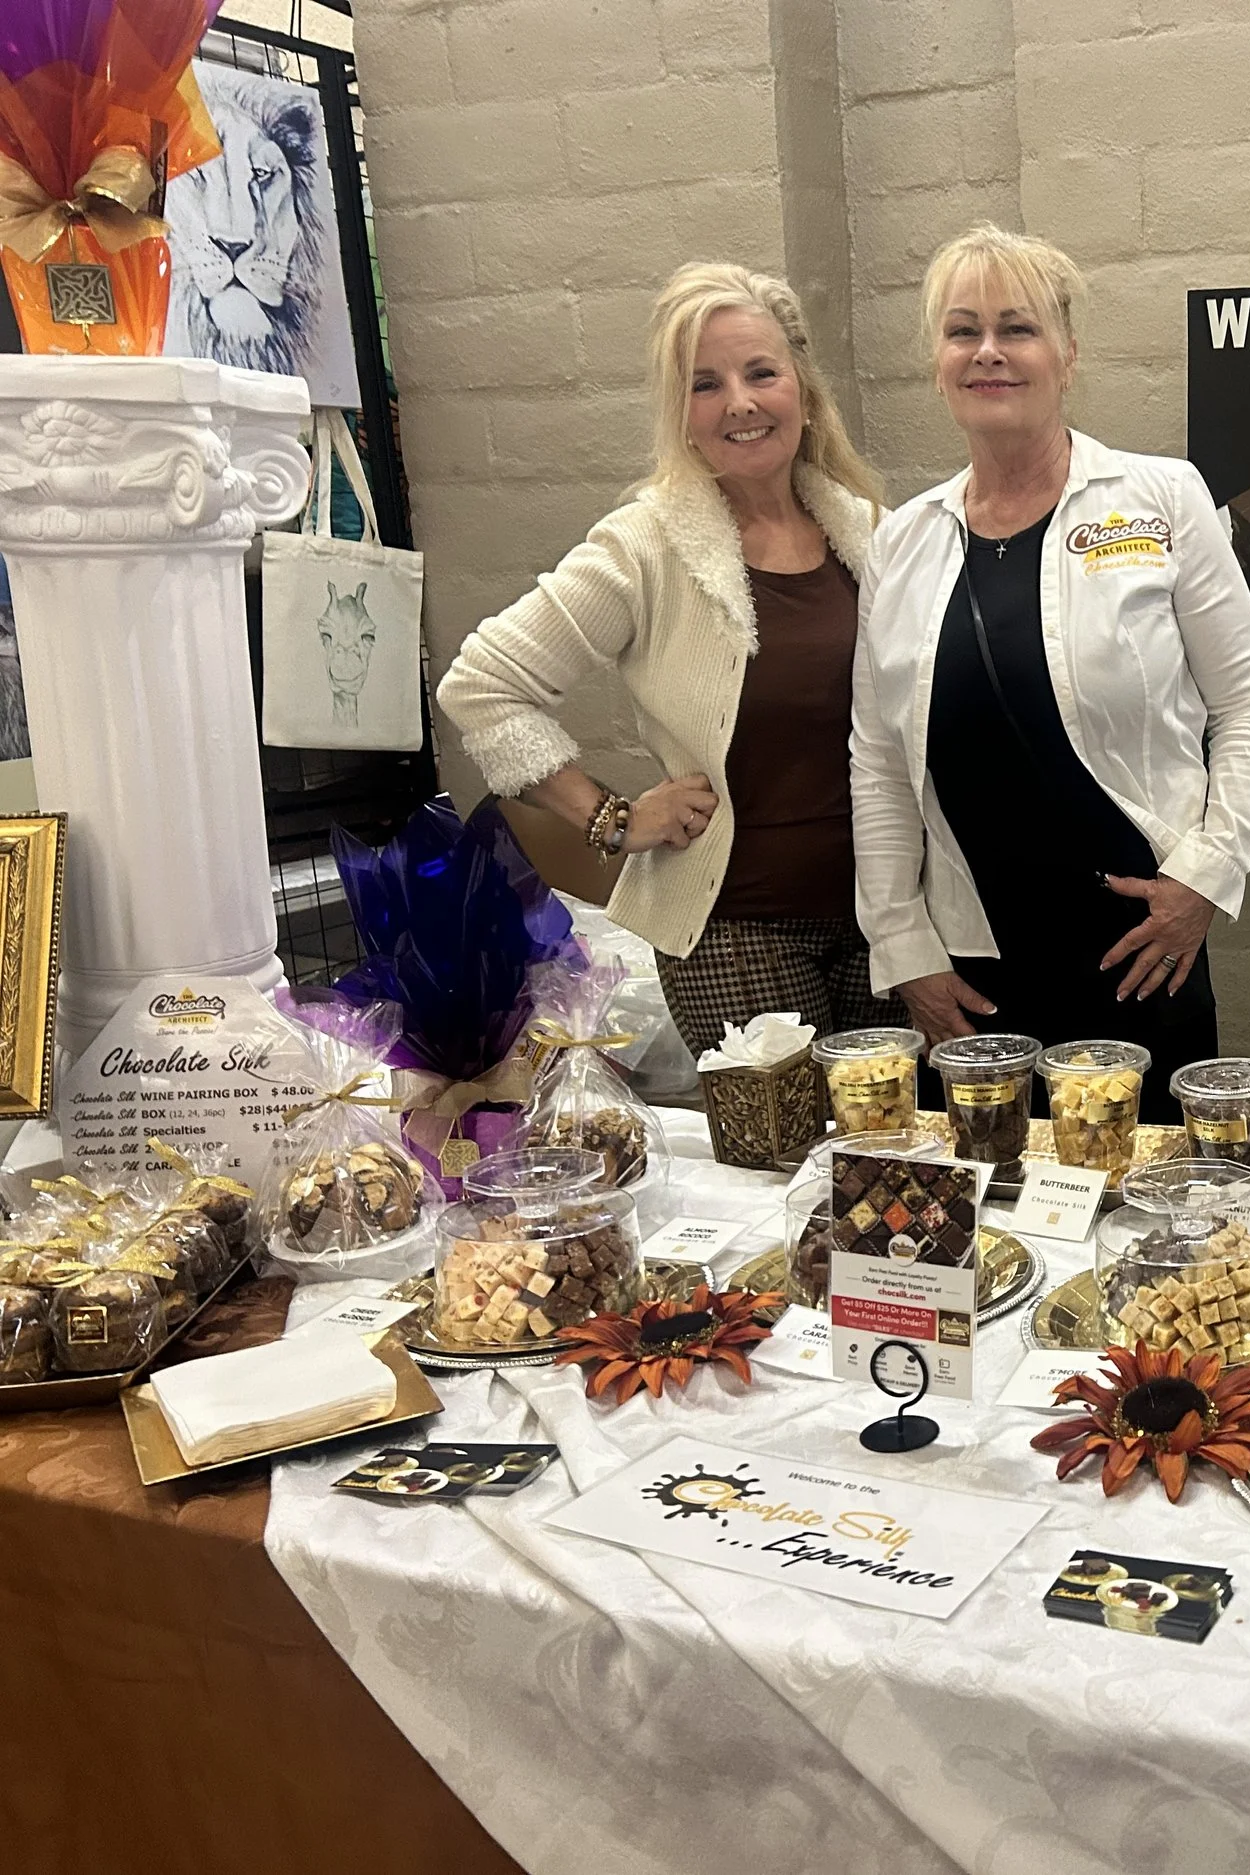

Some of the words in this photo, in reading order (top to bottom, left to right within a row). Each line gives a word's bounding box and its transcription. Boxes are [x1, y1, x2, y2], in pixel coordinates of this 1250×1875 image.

[1069, 519, 1169, 552] Chocolate
[1095, 543, 1151, 558] ARCHITECT
[151, 996, 225, 1017] Chocolate
[167, 1016, 208, 1024] ARCHITECT
[101, 1046, 210, 1078] Chocolate
[221, 1043, 272, 1071] Silk
[117, 1089, 136, 1101] Silk
[141, 1092, 174, 1101] WINE
[177, 1089, 230, 1100] PAIRING
[234, 1087, 259, 1098] BOX
[117, 1108, 136, 1120] Silk
[141, 1109, 166, 1119] BOX
[119, 1125, 136, 1137] Silk
[143, 1124, 206, 1137] Specialties
[119, 1143, 138, 1155] Silk
[1040, 1179, 1091, 1194] BUTTERBEER
[1031, 1195, 1069, 1210] Chocolate
[1071, 1201, 1087, 1211] Silk
[861, 1275, 881, 1285] Order
[882, 1278, 907, 1290] directly
[907, 1281, 924, 1291] from
[877, 1287, 927, 1302] chocsilk.com
[841, 1298, 853, 1308] Get
[864, 1302, 876, 1311] Off
[890, 1306, 900, 1314] Or
[901, 1307, 920, 1318] More
[921, 1310, 932, 1319] On
[844, 1308, 860, 1318] Your
[861, 1311, 876, 1321] First
[877, 1313, 900, 1324] Online
[787, 1471, 840, 1490] Welcome
[844, 1481, 857, 1491] to
[859, 1483, 880, 1496] the
[672, 1479, 823, 1527] Chocolate
[761, 1531, 954, 1590] Experience
